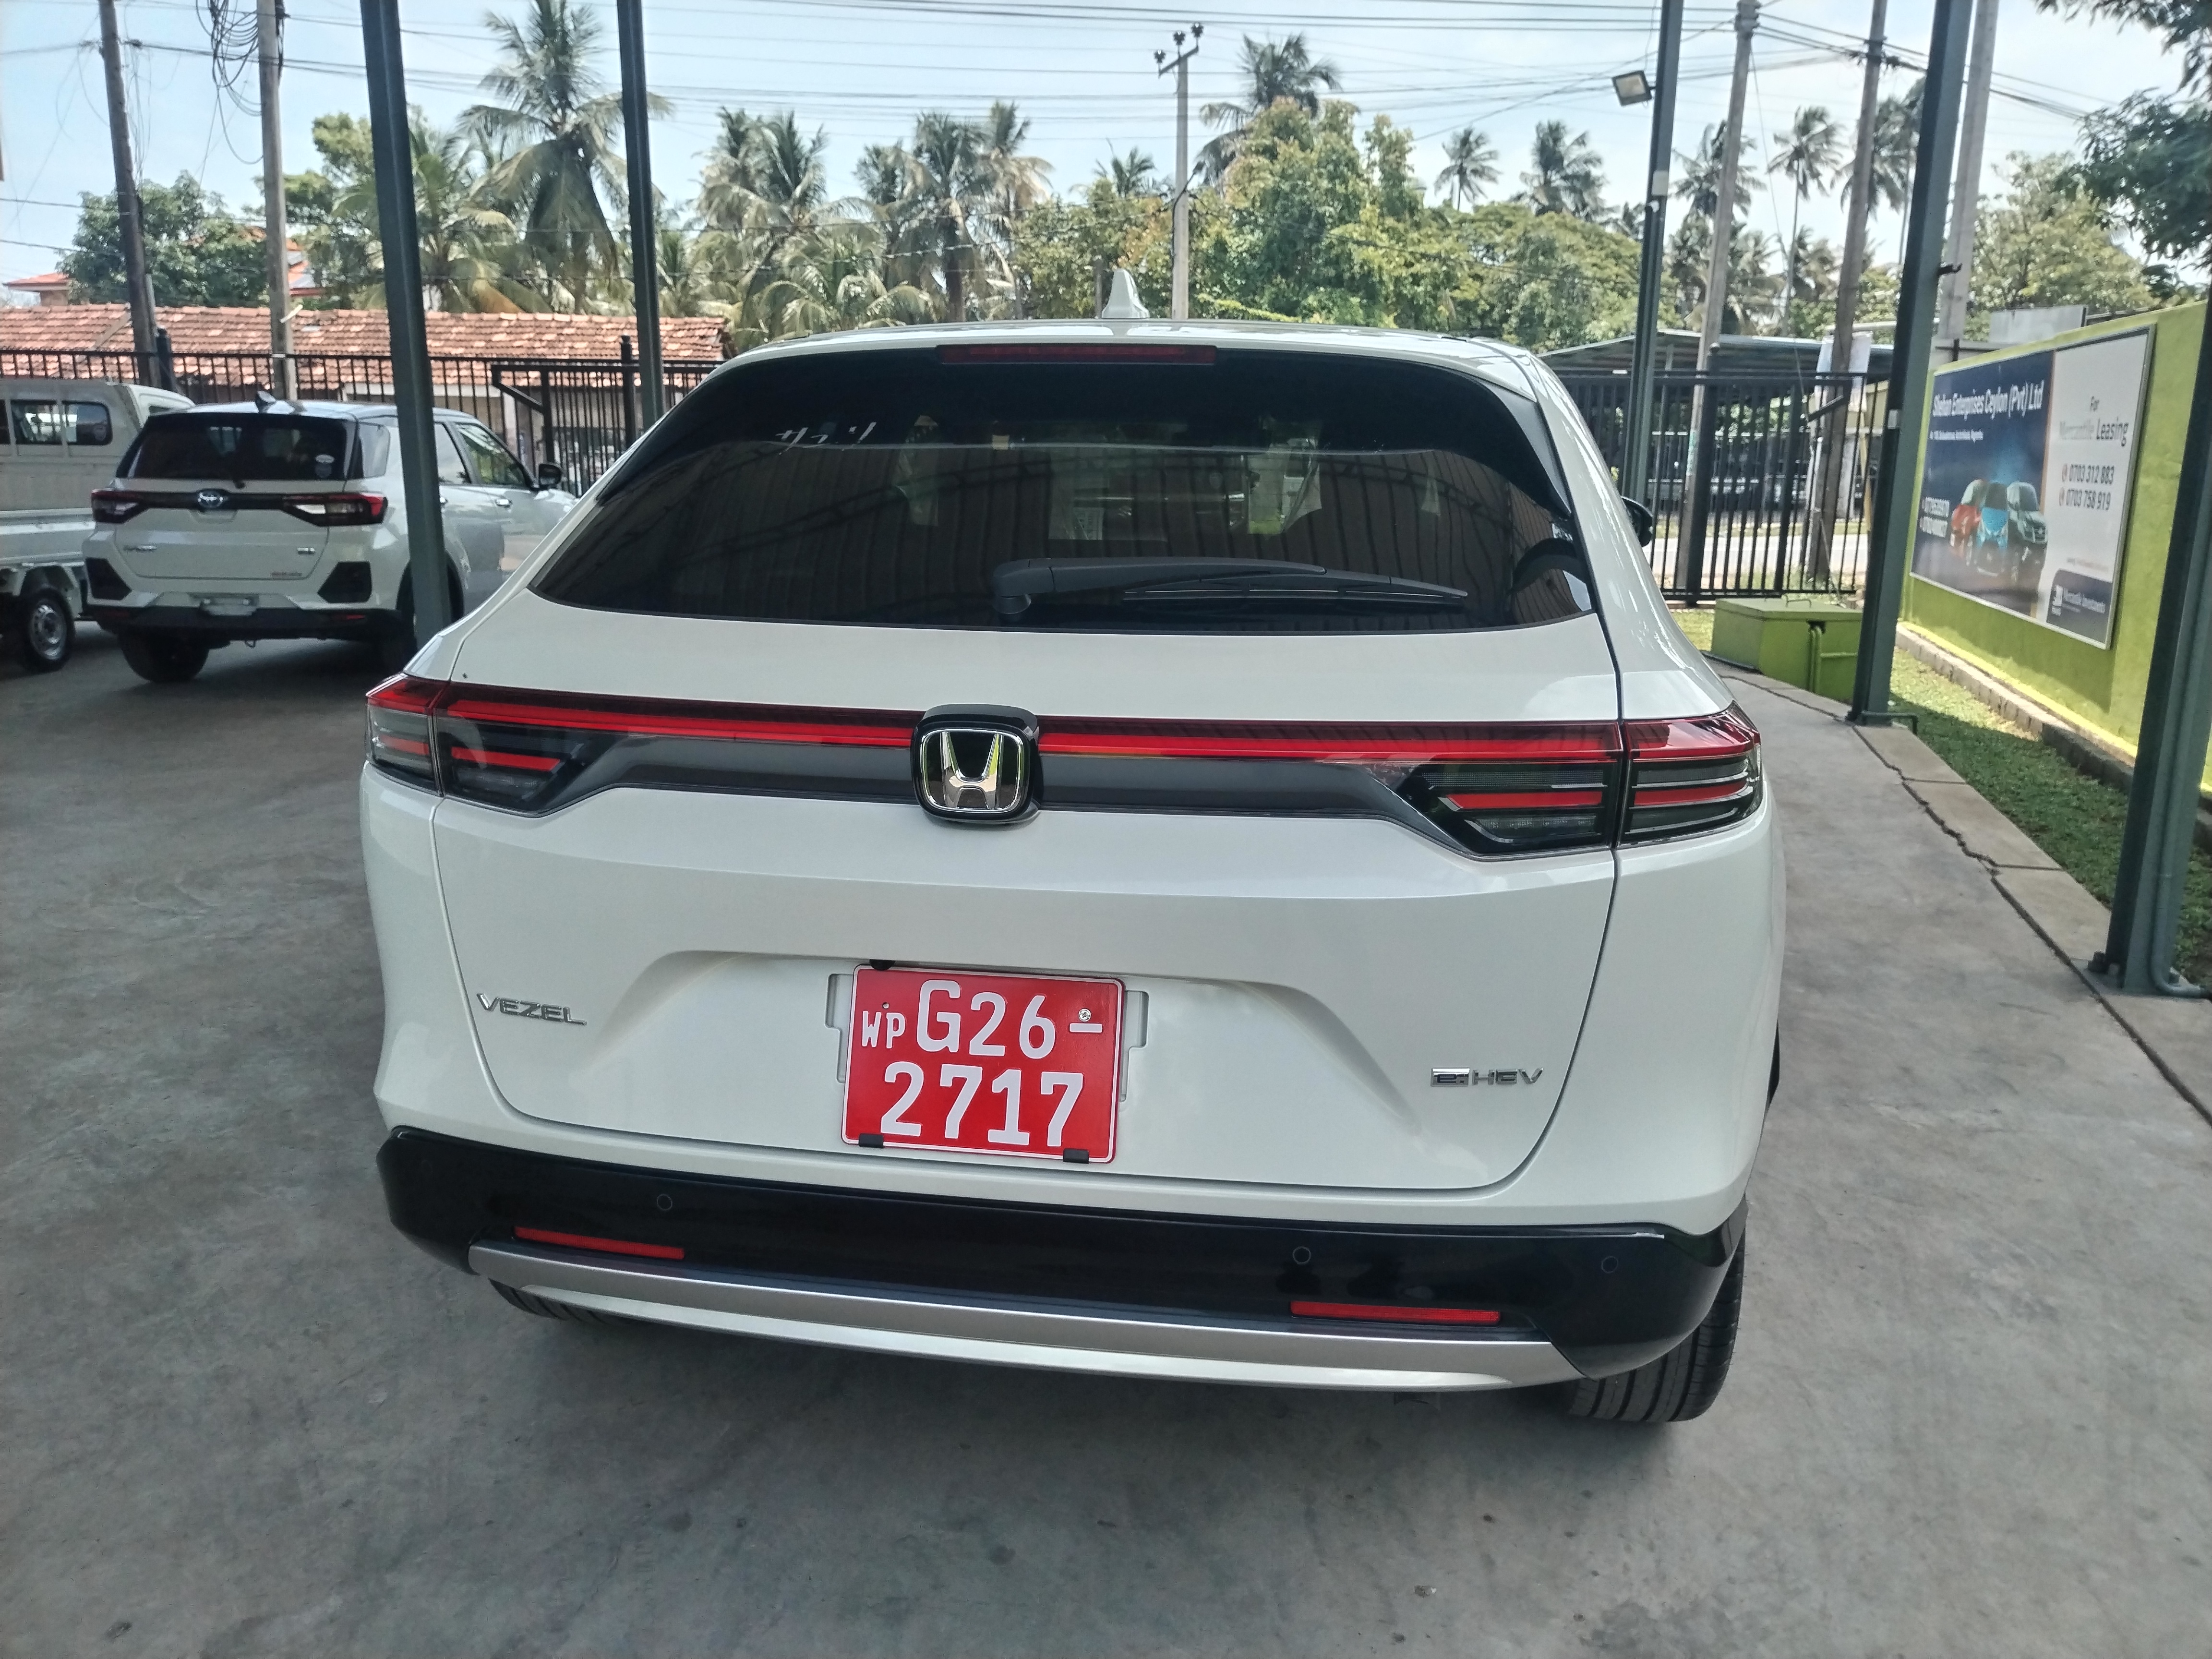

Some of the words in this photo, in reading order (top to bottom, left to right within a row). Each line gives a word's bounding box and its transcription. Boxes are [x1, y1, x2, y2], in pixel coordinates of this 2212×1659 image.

[2096, 416, 2129, 447] Leasing
[477, 992, 587, 1025] VEZEL
[862, 1010, 906, 1049] WP
[880, 1061, 1083, 1147] 2717
